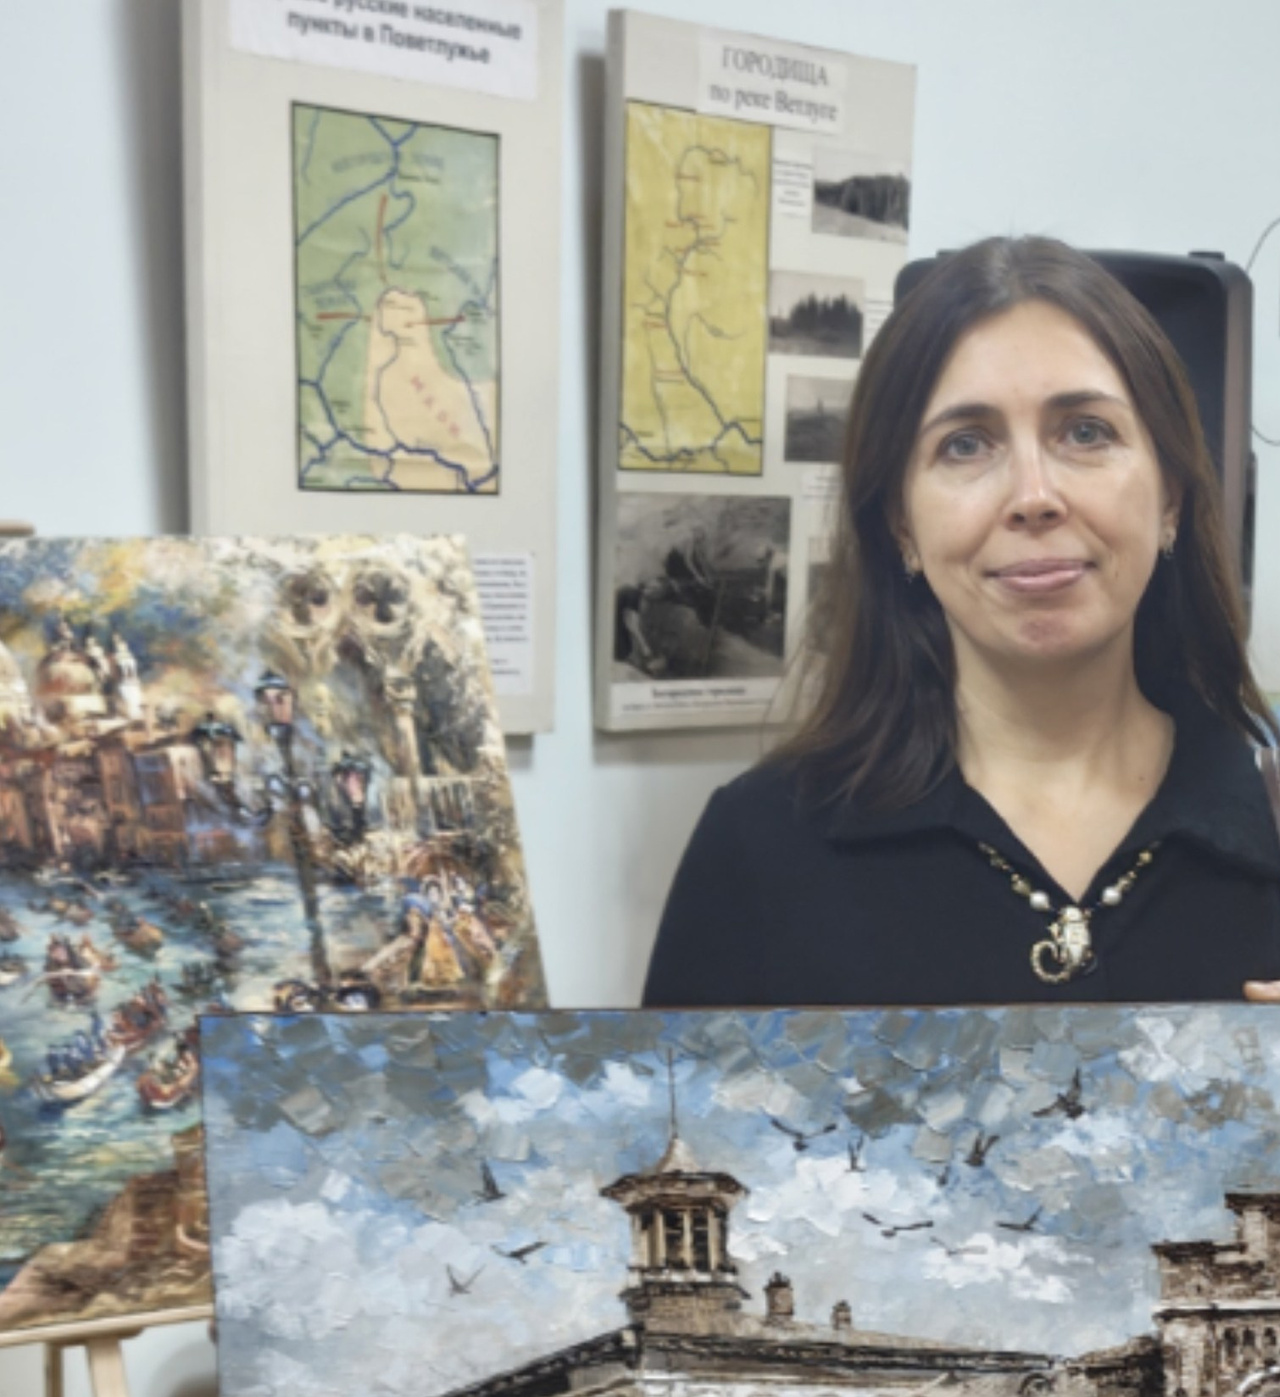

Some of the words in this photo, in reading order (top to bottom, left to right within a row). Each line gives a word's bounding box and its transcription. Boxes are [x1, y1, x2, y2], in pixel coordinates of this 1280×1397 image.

[286, 10, 359, 38] пункты
[363, 25, 375, 42] в
[379, 22, 491, 63] Поветлужье
[412, 4, 522, 41] населенные
[721, 45, 829, 86] ГОРОДИЩА
[709, 84, 731, 103] по
[734, 88, 772, 111] реке
[774, 89, 838, 124] Ветлуге
